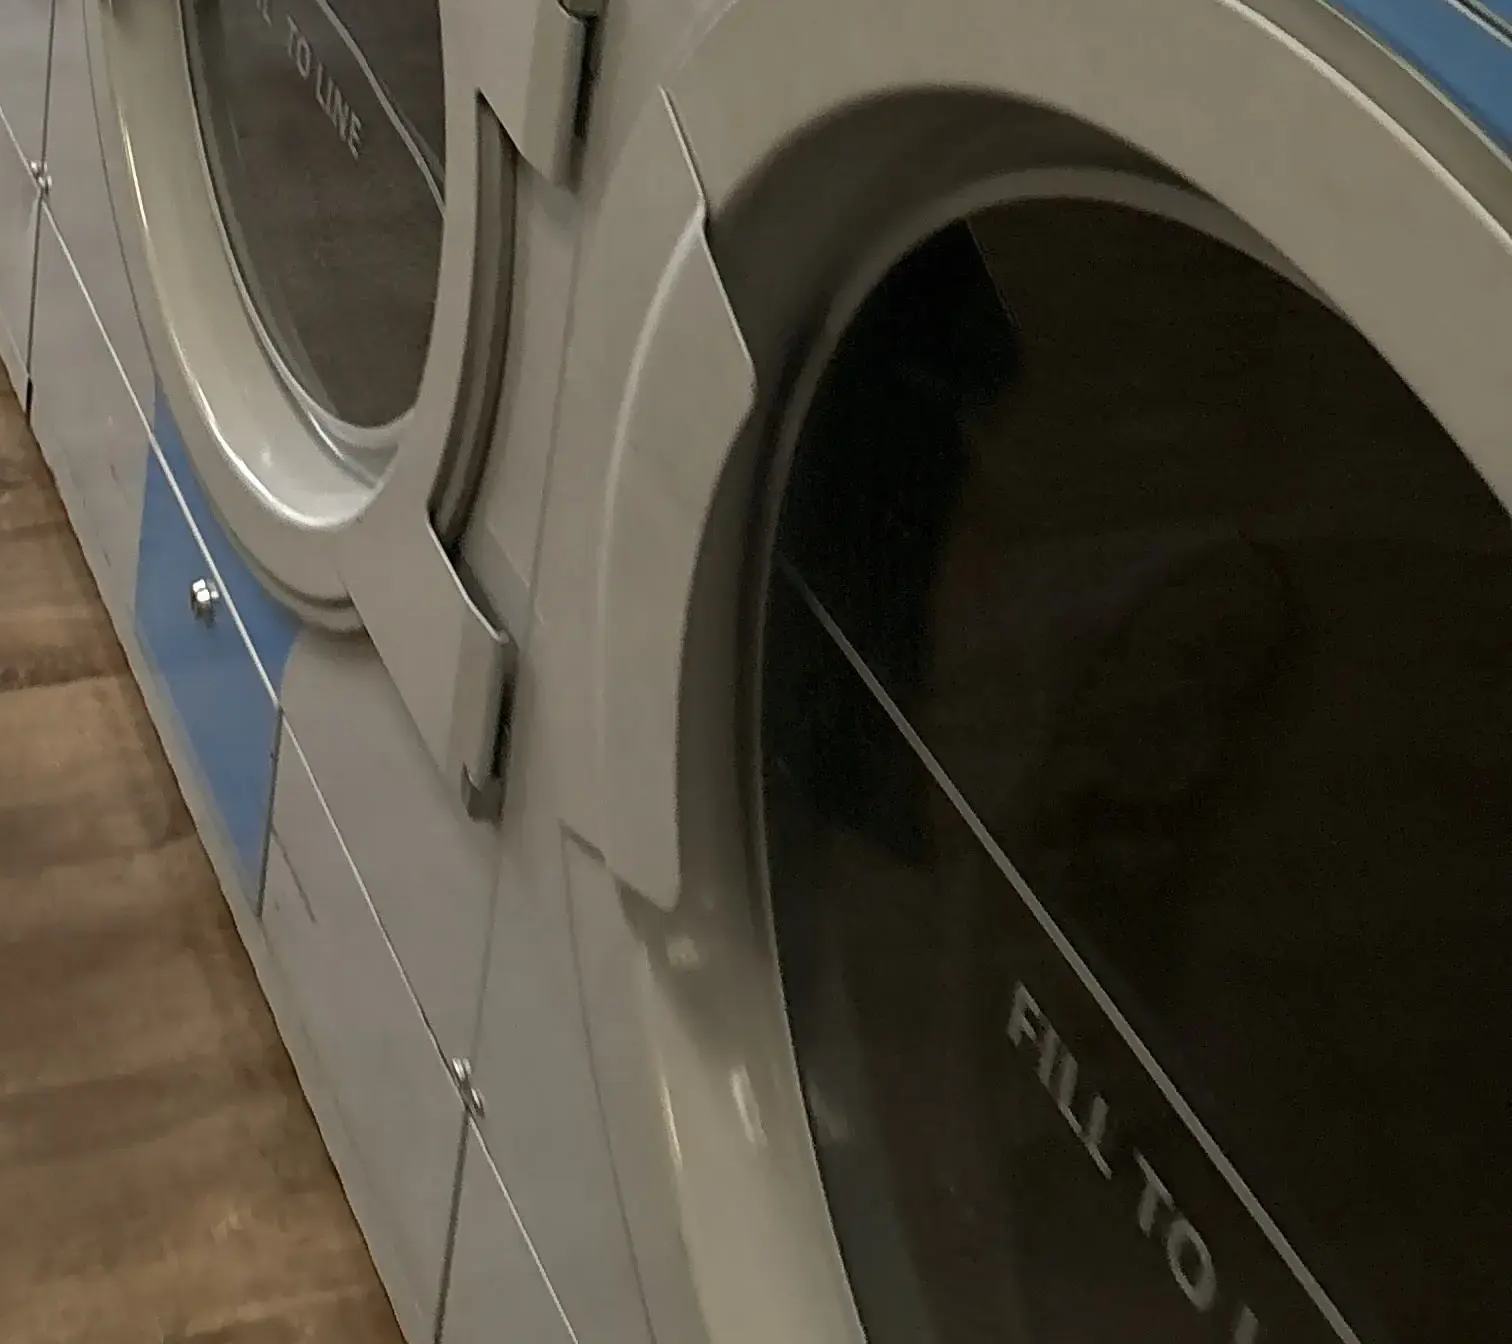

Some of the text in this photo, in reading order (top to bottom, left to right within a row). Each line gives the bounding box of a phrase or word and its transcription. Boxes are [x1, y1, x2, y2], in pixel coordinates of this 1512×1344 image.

[285, 9, 312, 81] TO
[315, 61, 362, 162] LINE
[1006, 978, 1218, 1313] FILL TO
